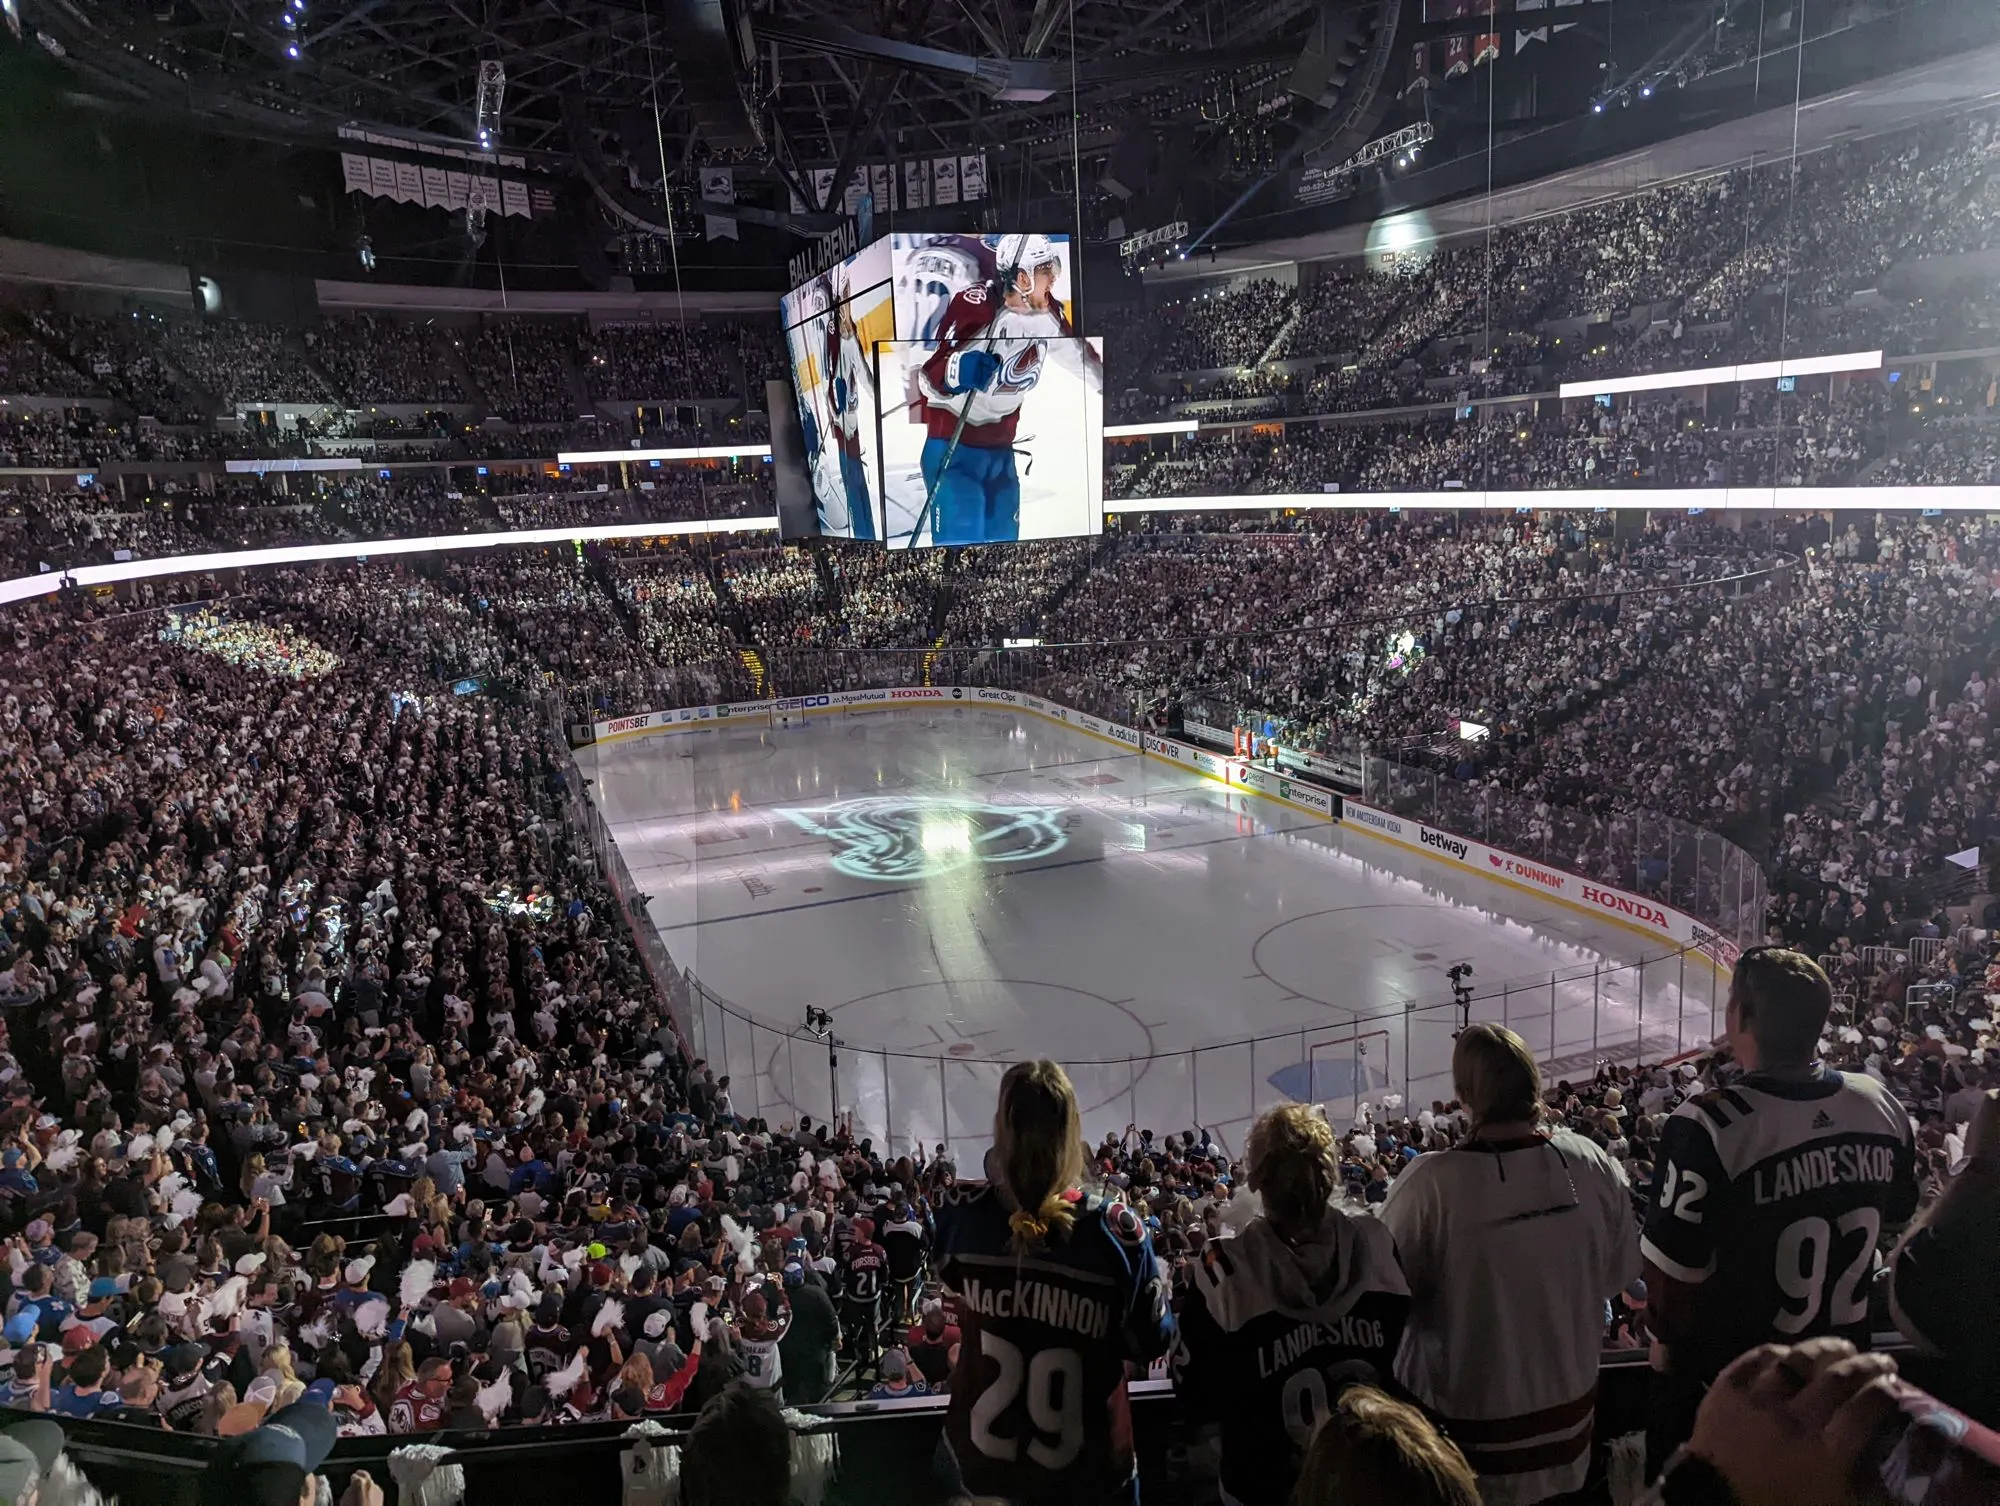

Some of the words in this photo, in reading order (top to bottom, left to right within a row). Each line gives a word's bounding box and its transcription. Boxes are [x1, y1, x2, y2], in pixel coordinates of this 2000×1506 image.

[789, 247, 816, 289] BALL
[817, 218, 857, 272] ARENA
[776, 695, 829, 711] GEICO
[841, 692, 886, 702] MassMutual
[891, 690, 943, 698] HONDA
[978, 689, 1001, 699] Great
[1001, 692, 1016, 703] Clips
[608, 715, 650, 733] POINTSBET
[1146, 737, 1179, 759] DISCOVER
[1345, 805, 1355, 818] NEW
[1356, 809, 1386, 830] AMSTERDAM
[1420, 827, 1468, 860] betway
[1582, 885, 1669, 929] HONDA
[321, 1174, 333, 1195] 8
[1754, 1144, 1895, 1204] LANDESKOG
[851, 1256, 881, 1271] FORSBER
[1772, 1206, 1881, 1334] 92
[856, 1270, 877, 1296] 21
[1258, 1315, 1385, 1379] LANDESKOG
[748, 1355, 762, 1377] 8
[970, 1329, 1084, 1470] 29
